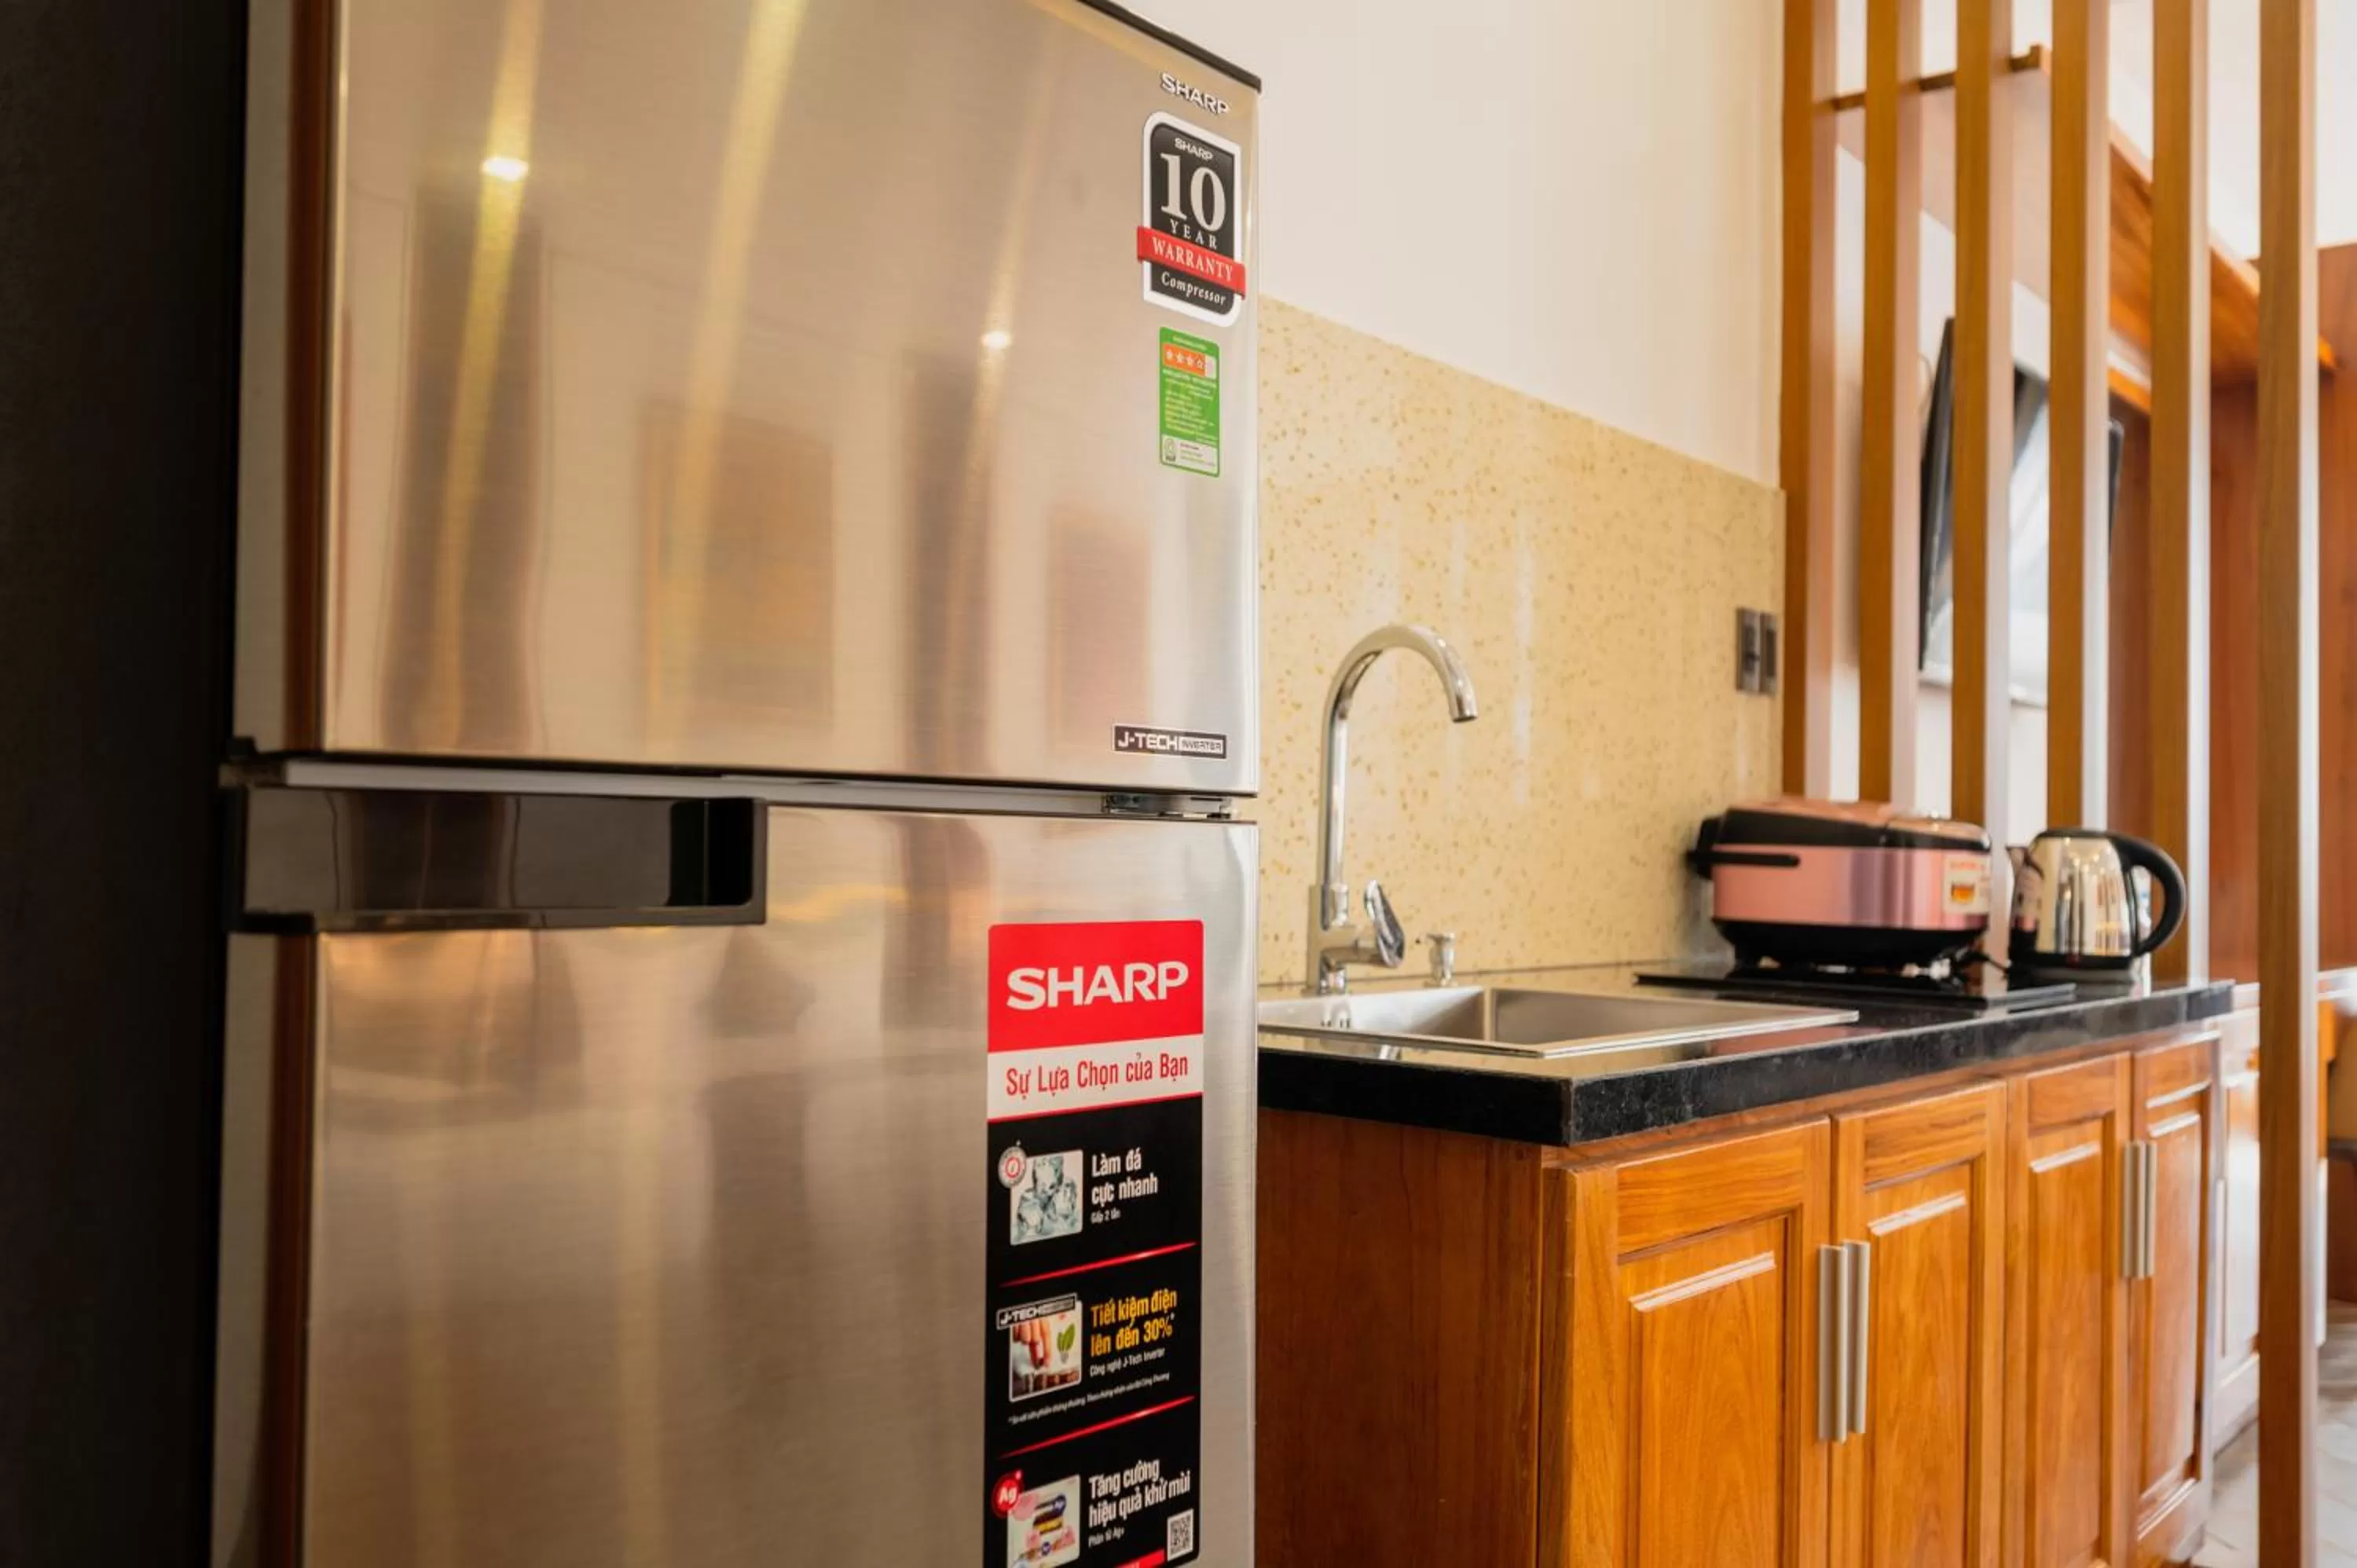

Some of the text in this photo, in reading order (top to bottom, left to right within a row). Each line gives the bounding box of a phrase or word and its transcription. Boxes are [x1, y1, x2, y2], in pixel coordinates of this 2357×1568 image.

[1160, 71, 1231, 115] SHARP
[1175, 137, 1214, 161] SHARP
[1160, 152, 1226, 232] 10
[1169, 218, 1218, 249] YEAR
[1152, 236, 1233, 282] WARRANTY
[1161, 271, 1226, 306] Compressor
[1118, 731, 1222, 752] J-TECH INVERTER
[1006, 961, 1189, 1010] SHARP
[1006, 1052, 1188, 1100] Sự Lựa Chọn của Bạn
[1091, 1146, 1142, 1178] Làm đá
[1091, 1171, 1158, 1207] cực nhanh
[1091, 1296, 1116, 1328] Tiết
[1118, 1295, 1149, 1322] kiệm
[1151, 1288, 1177, 1314] điện
[1091, 1332, 1111, 1357] lên
[1116, 1320, 1139, 1350] đến
[1088, 1459, 1160, 1500] Tăng cường
[1088, 1498, 1116, 1529] hiệu
[1119, 1486, 1142, 1521] quả
[1168, 1469, 1191, 1498] mùi
